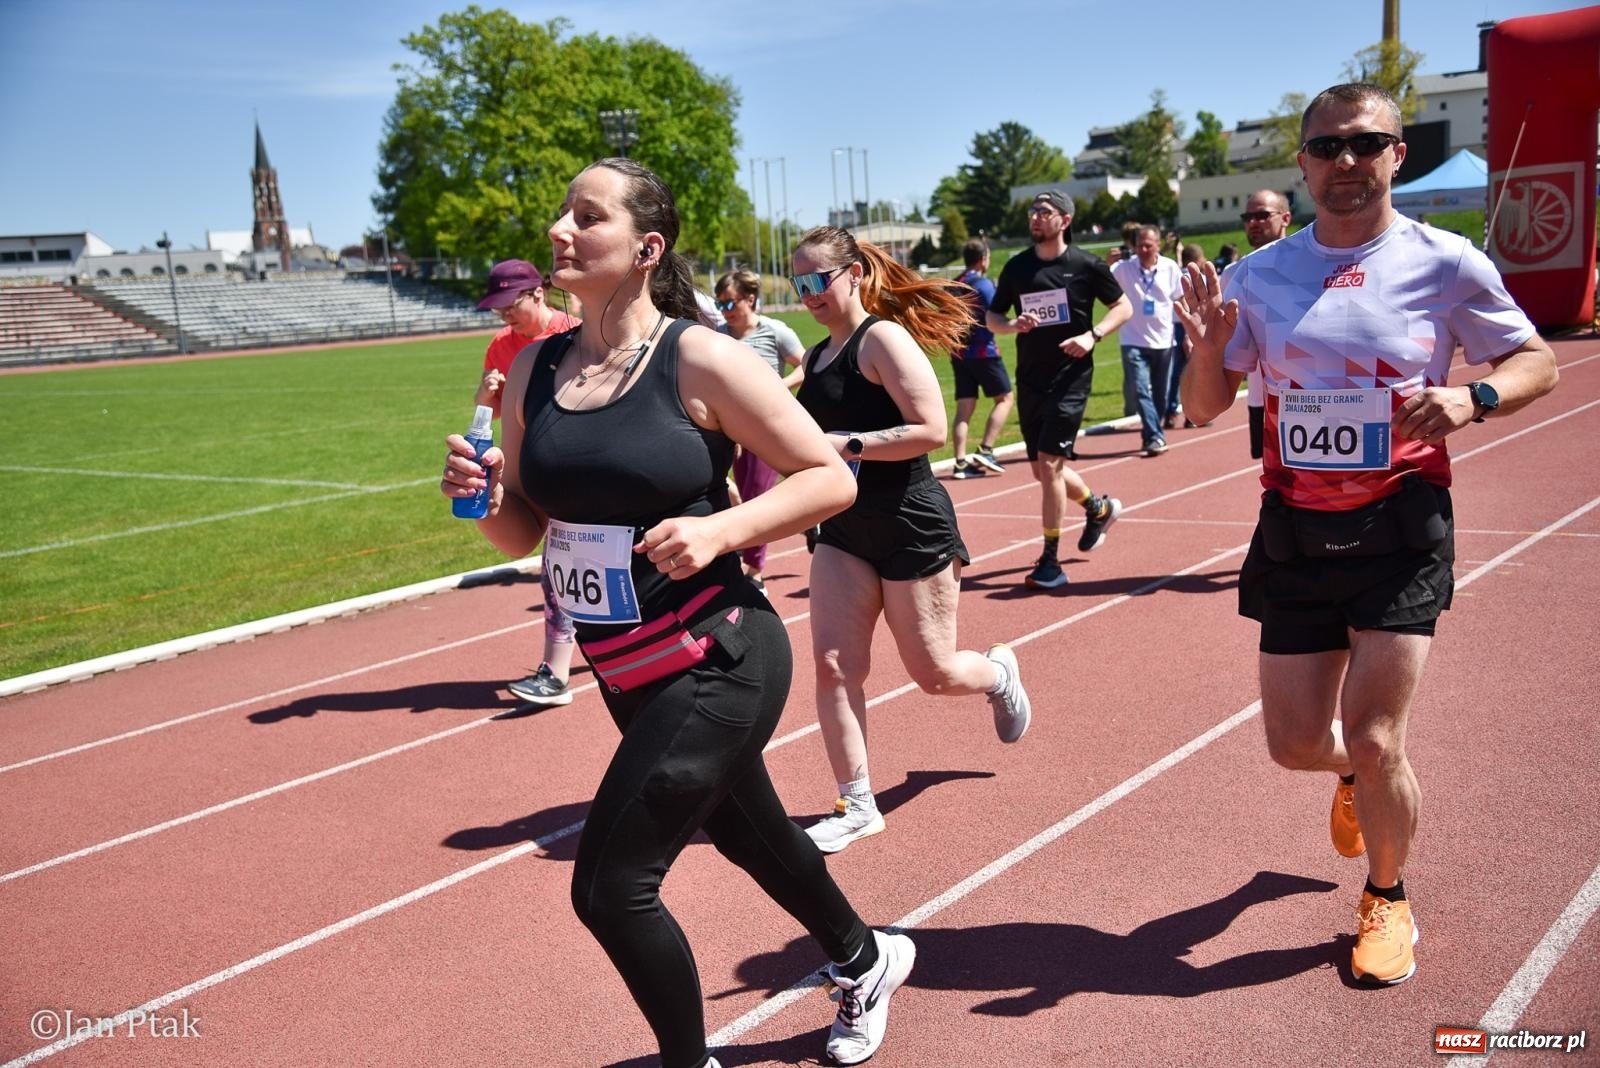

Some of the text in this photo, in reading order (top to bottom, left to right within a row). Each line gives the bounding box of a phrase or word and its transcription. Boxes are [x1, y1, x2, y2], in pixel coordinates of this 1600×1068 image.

[1332, 263, 1362, 274] JUST
[1326, 274, 1363, 287] HERO
[1285, 394, 1364, 404] XVIII BIEG BEZ GRANIC
[1289, 424, 1358, 456] 040
[577, 531, 605, 543] GRANIC
[552, 563, 602, 606] 046
